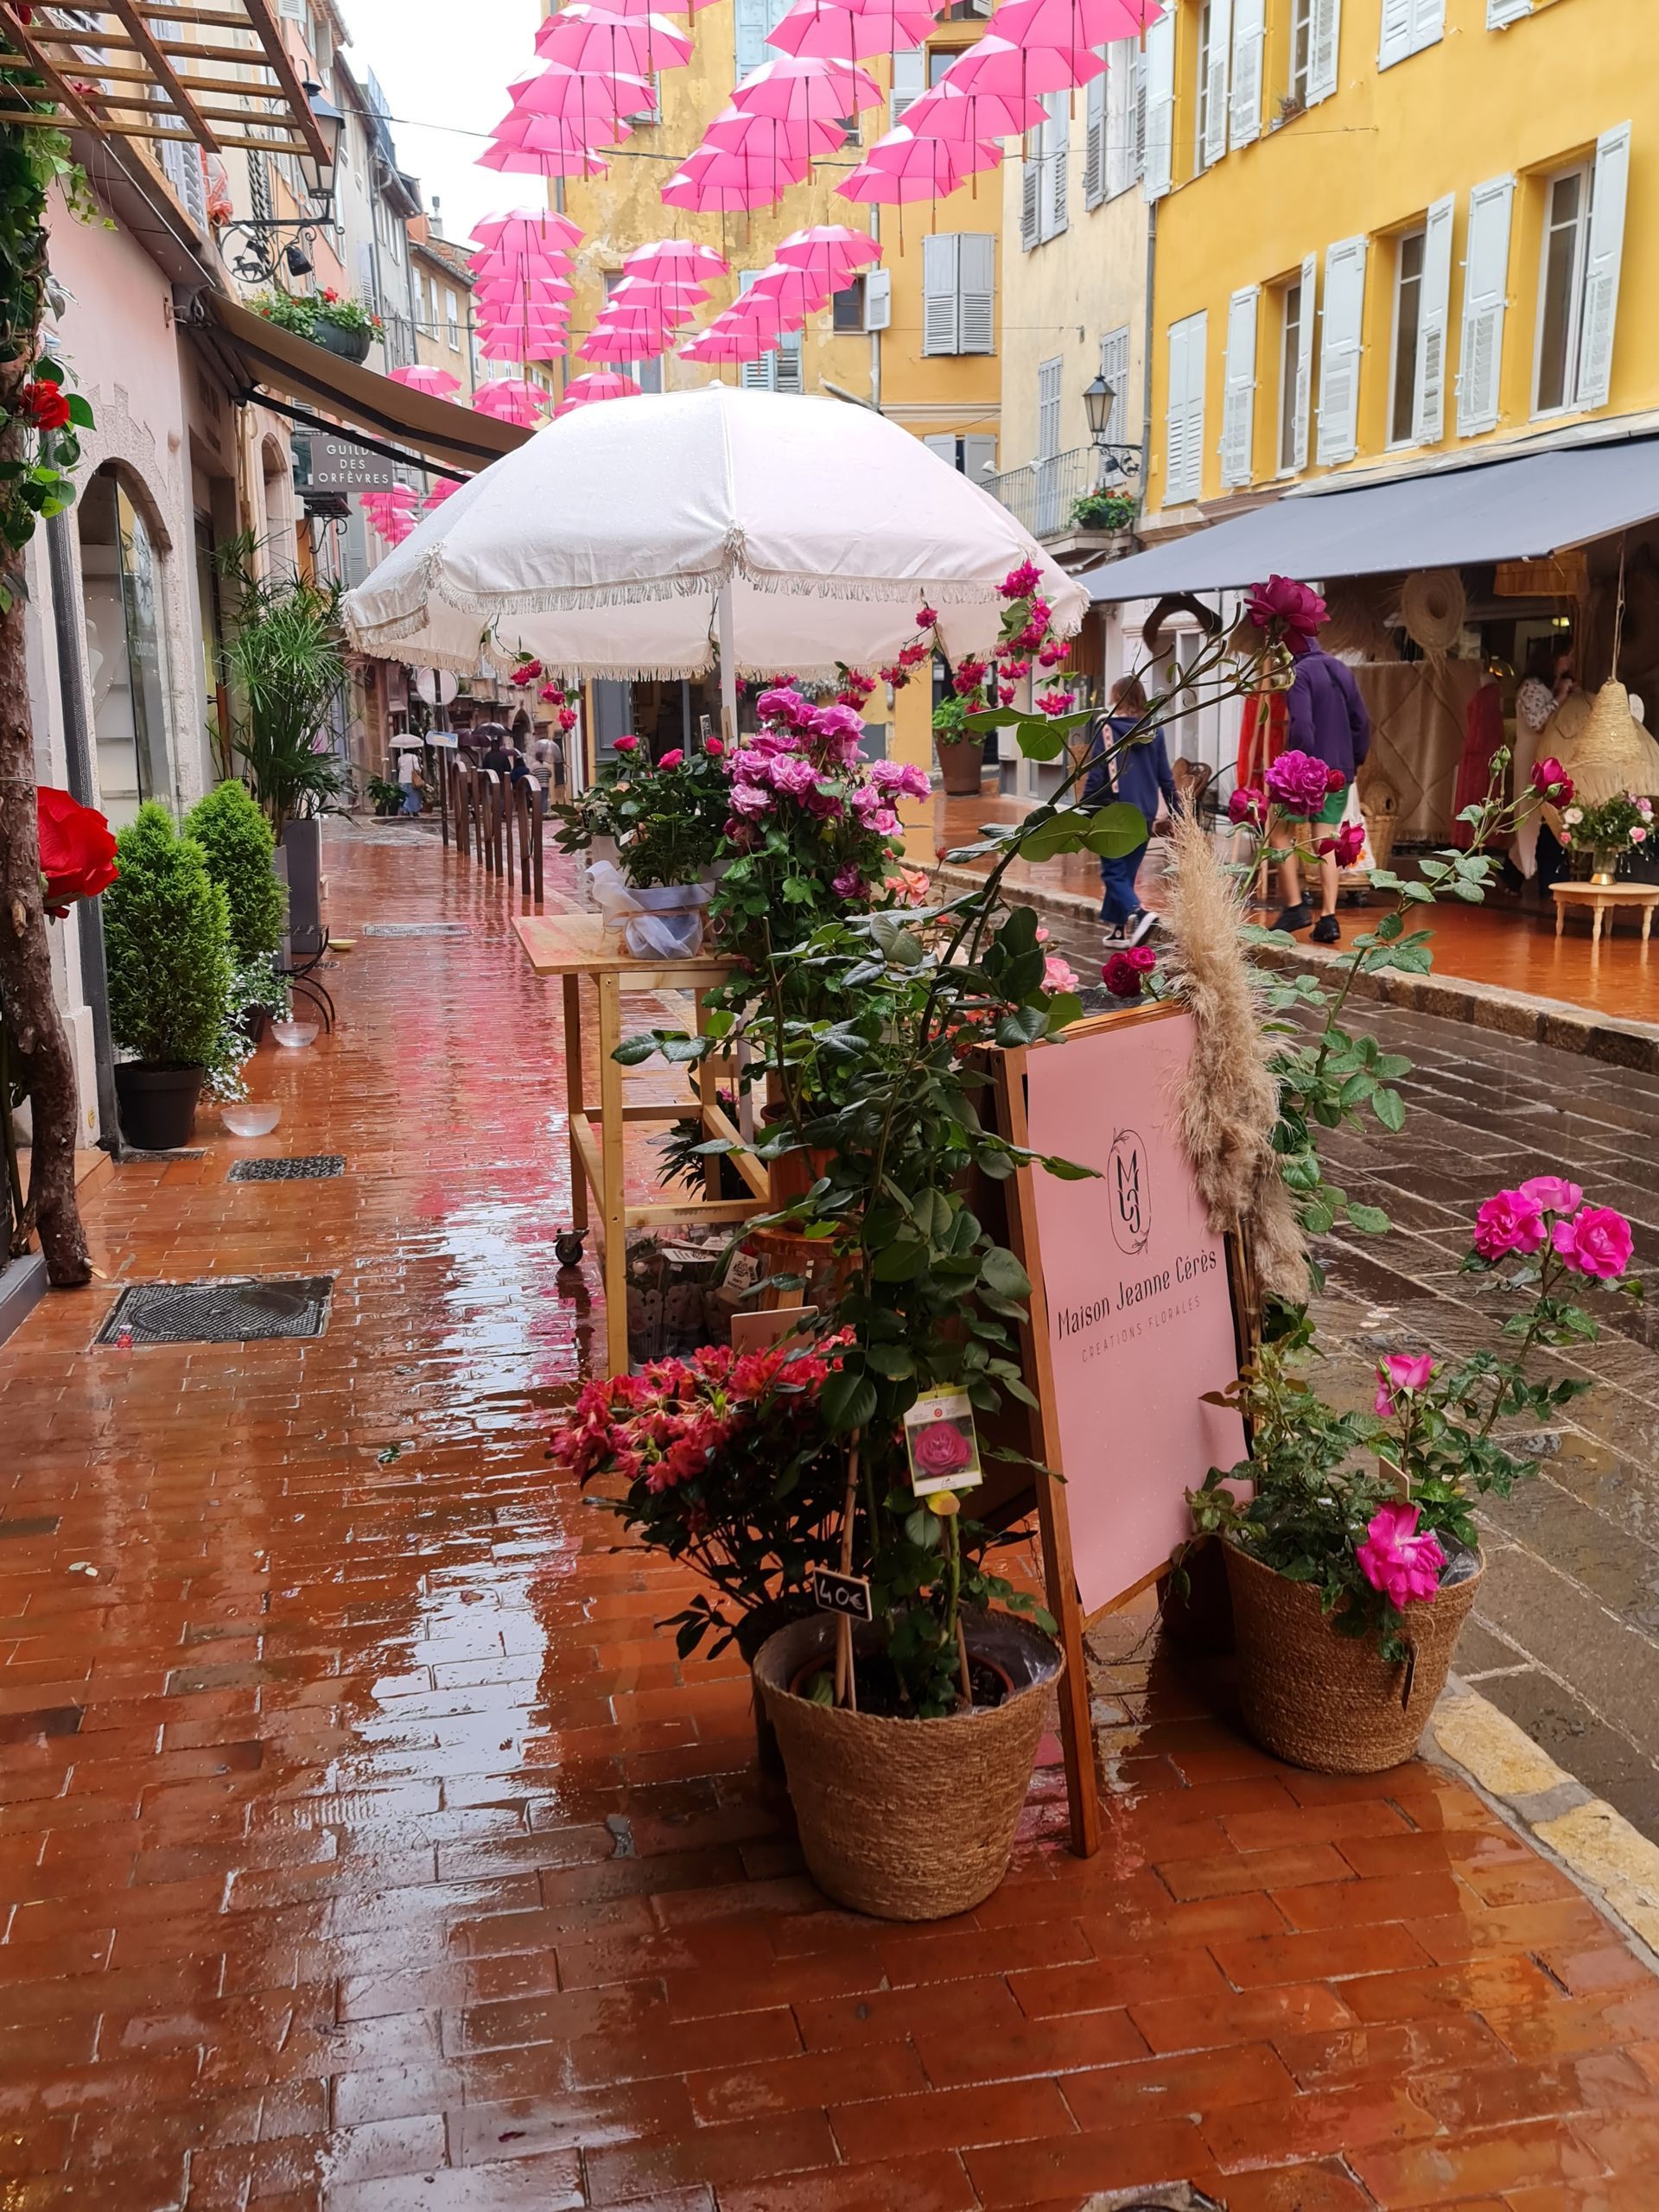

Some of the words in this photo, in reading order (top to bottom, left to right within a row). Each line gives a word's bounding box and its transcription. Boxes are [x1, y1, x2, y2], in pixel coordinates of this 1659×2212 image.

[318, 471, 389, 484] ORFÈVRES
[340, 459, 365, 469] DES
[1058, 1297, 1110, 1340] Maison
[1116, 1271, 1170, 1311] Jeanne
[1176, 1249, 1217, 1283] Cérès
[1082, 1322, 1143, 1363] CREATIONS
[1148, 1295, 1200, 1329] FLORALES
[820, 1579, 865, 1610] 40€
